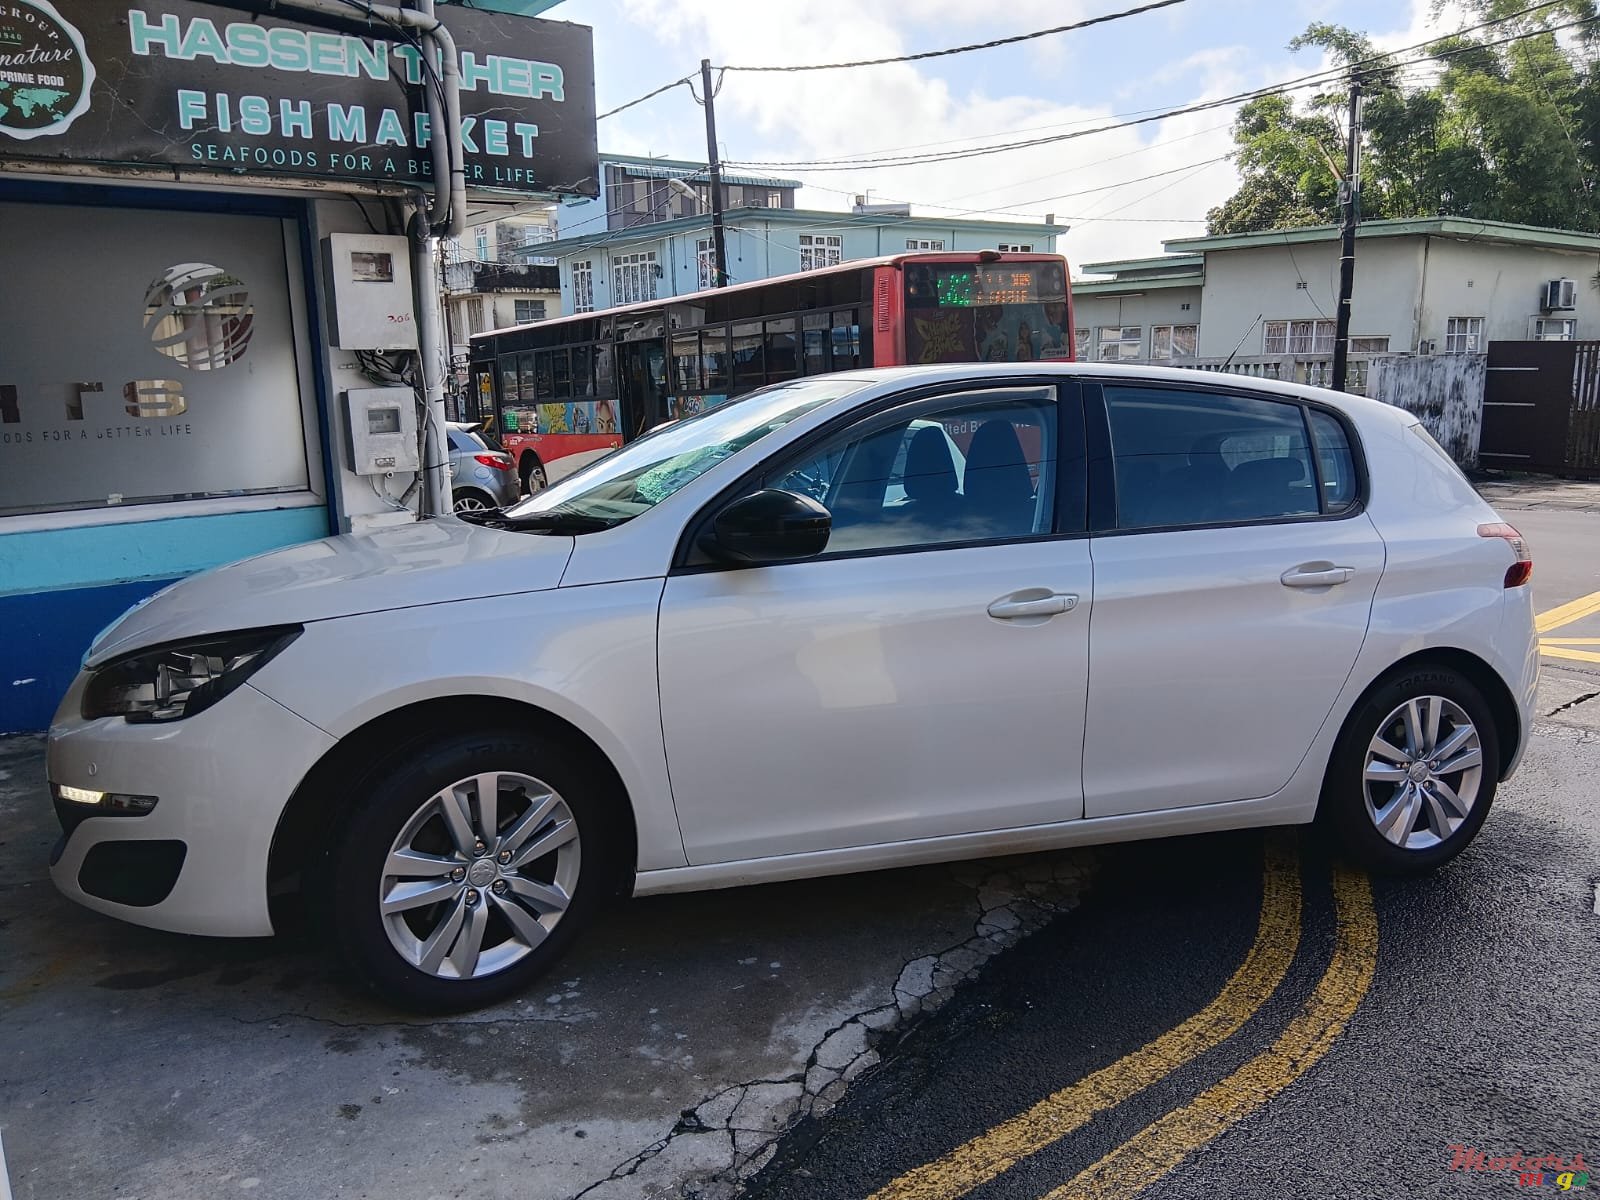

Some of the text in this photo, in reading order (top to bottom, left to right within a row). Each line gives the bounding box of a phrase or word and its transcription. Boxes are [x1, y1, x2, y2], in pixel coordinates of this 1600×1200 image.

[128, 9, 390, 82] HASSEN
[0, 70, 65, 87] PRIME FOOD
[177, 89, 314, 139] FISH
[191, 143, 536, 185] SEAFOODS FOR A BEER LIFE
[0, 379, 189, 424] TS
[43, 429, 72, 442] FOR
[80, 428, 88, 440] A
[160, 423, 193, 437] LIFE
